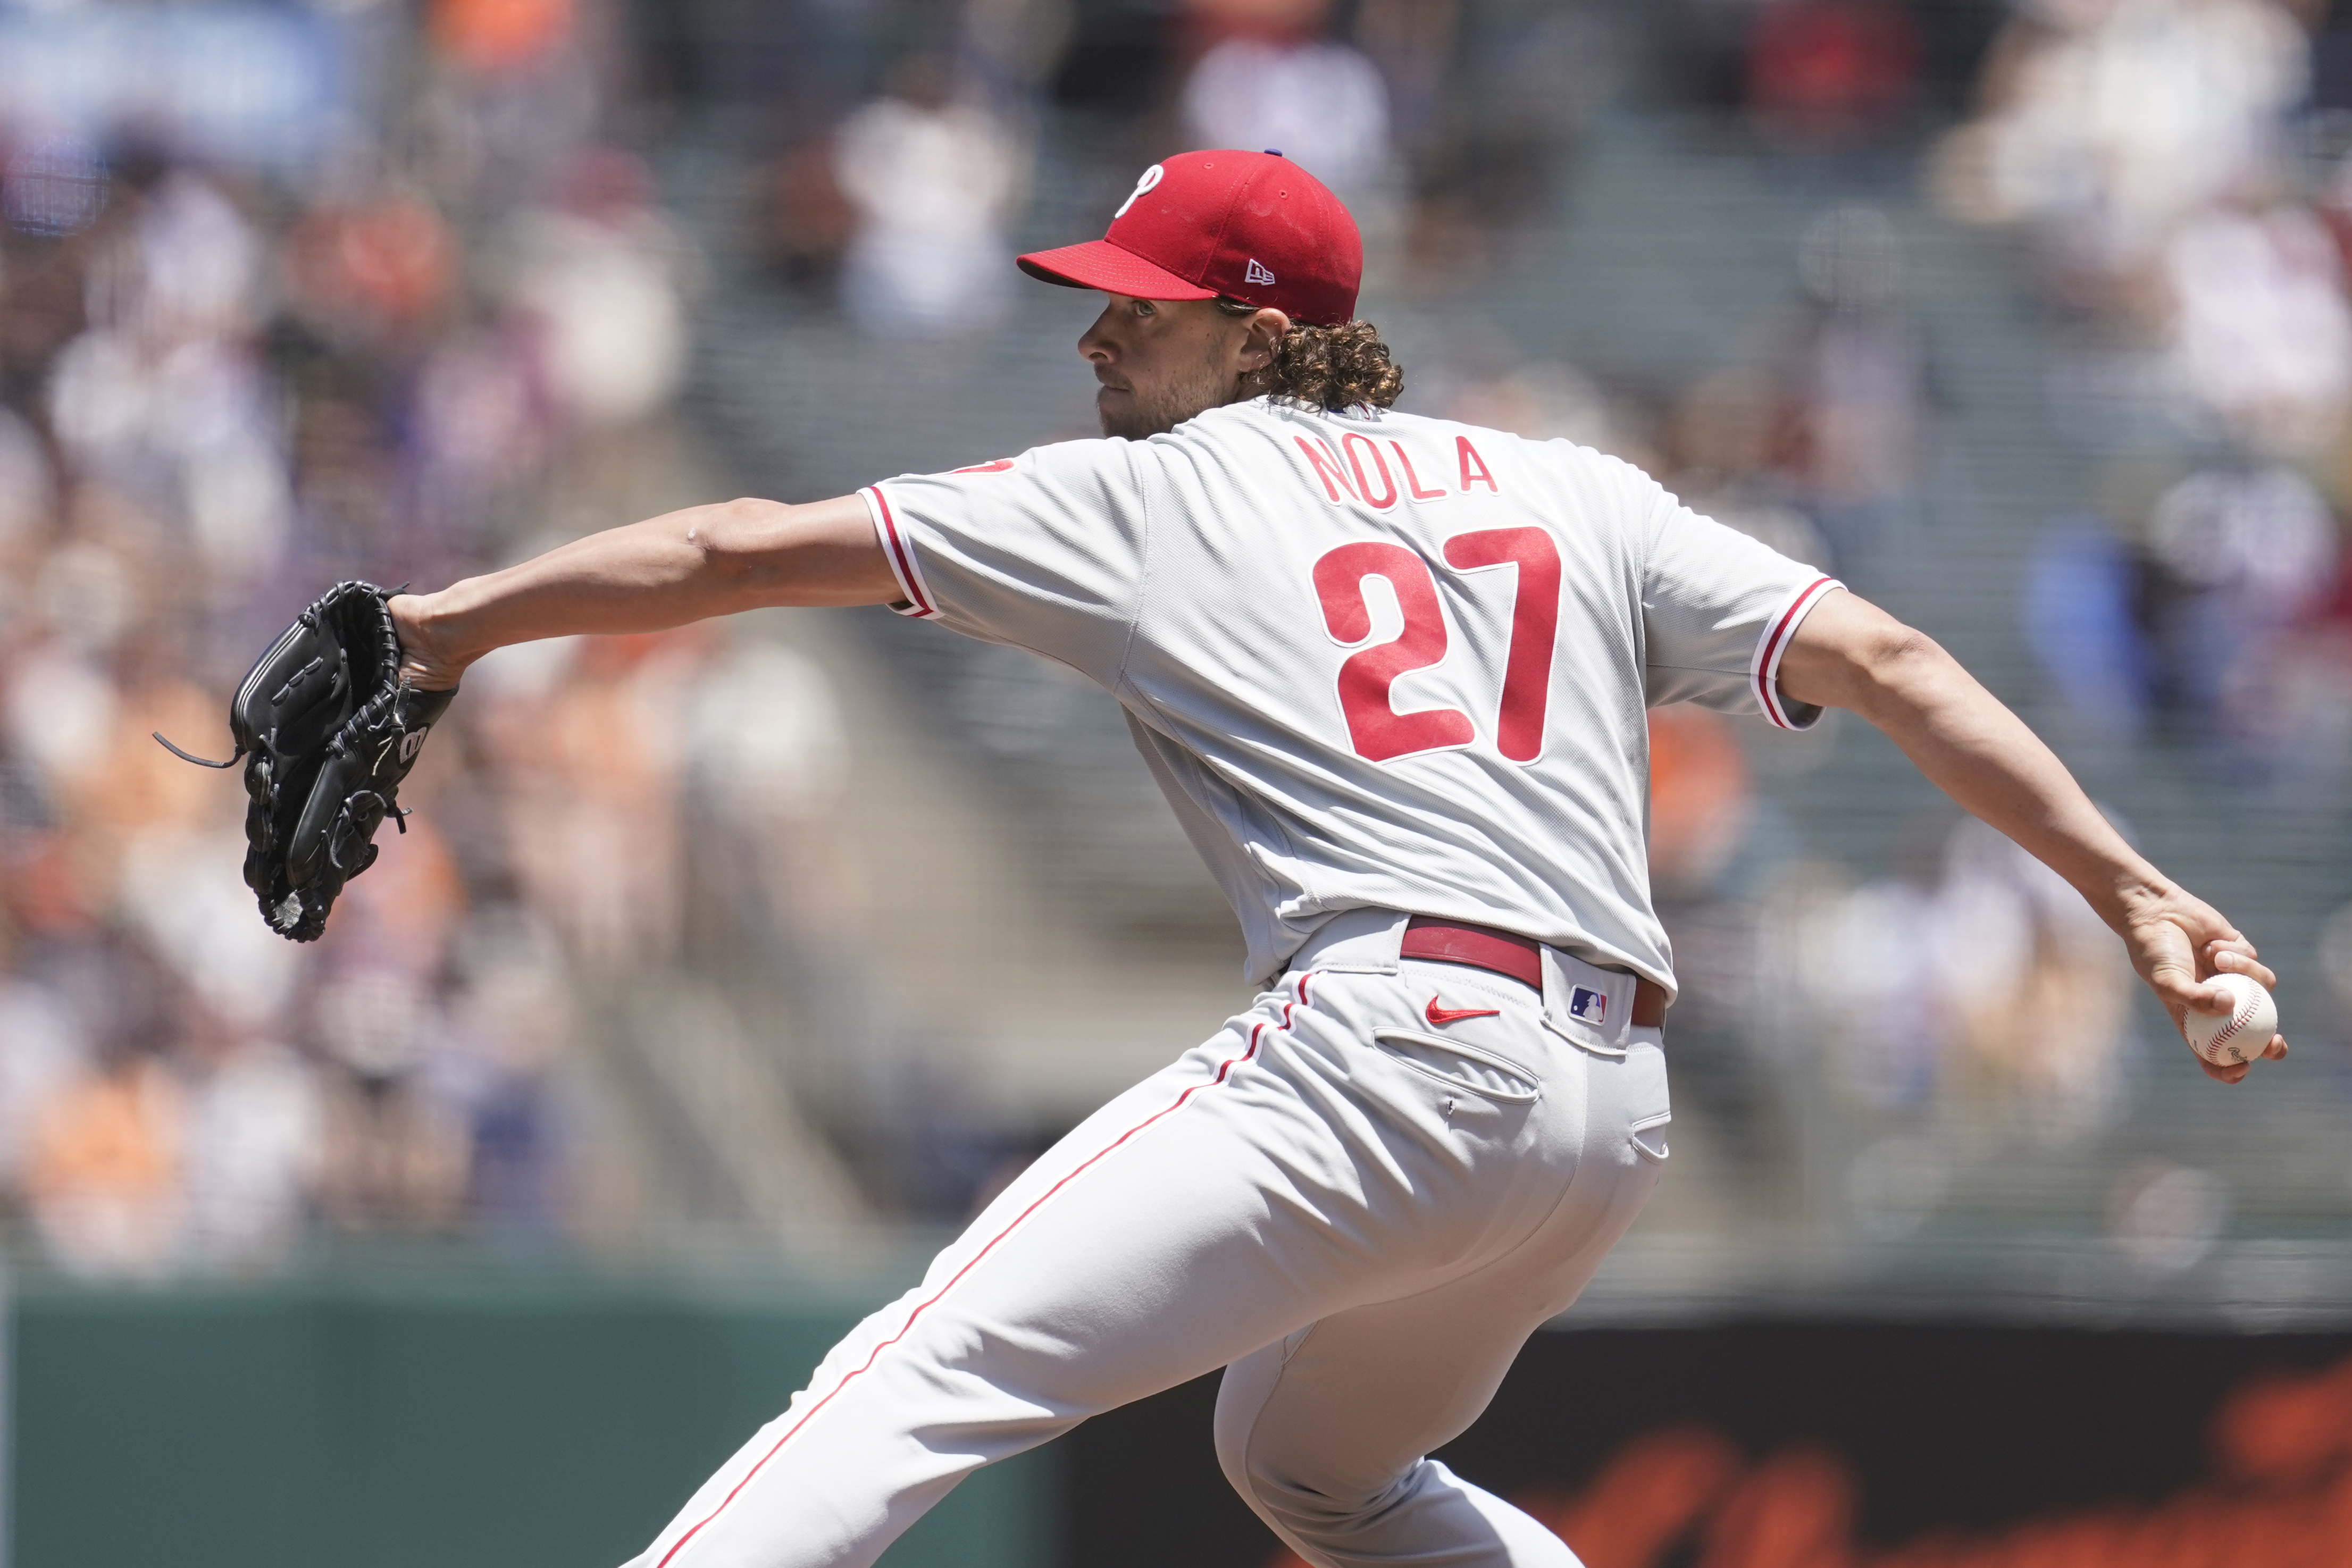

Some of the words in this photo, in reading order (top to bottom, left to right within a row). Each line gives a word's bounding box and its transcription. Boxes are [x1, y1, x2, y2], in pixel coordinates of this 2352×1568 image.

[1115, 164, 1164, 219] P
[1292, 431, 1500, 511] NOLA
[1310, 524, 1563, 764] 27
